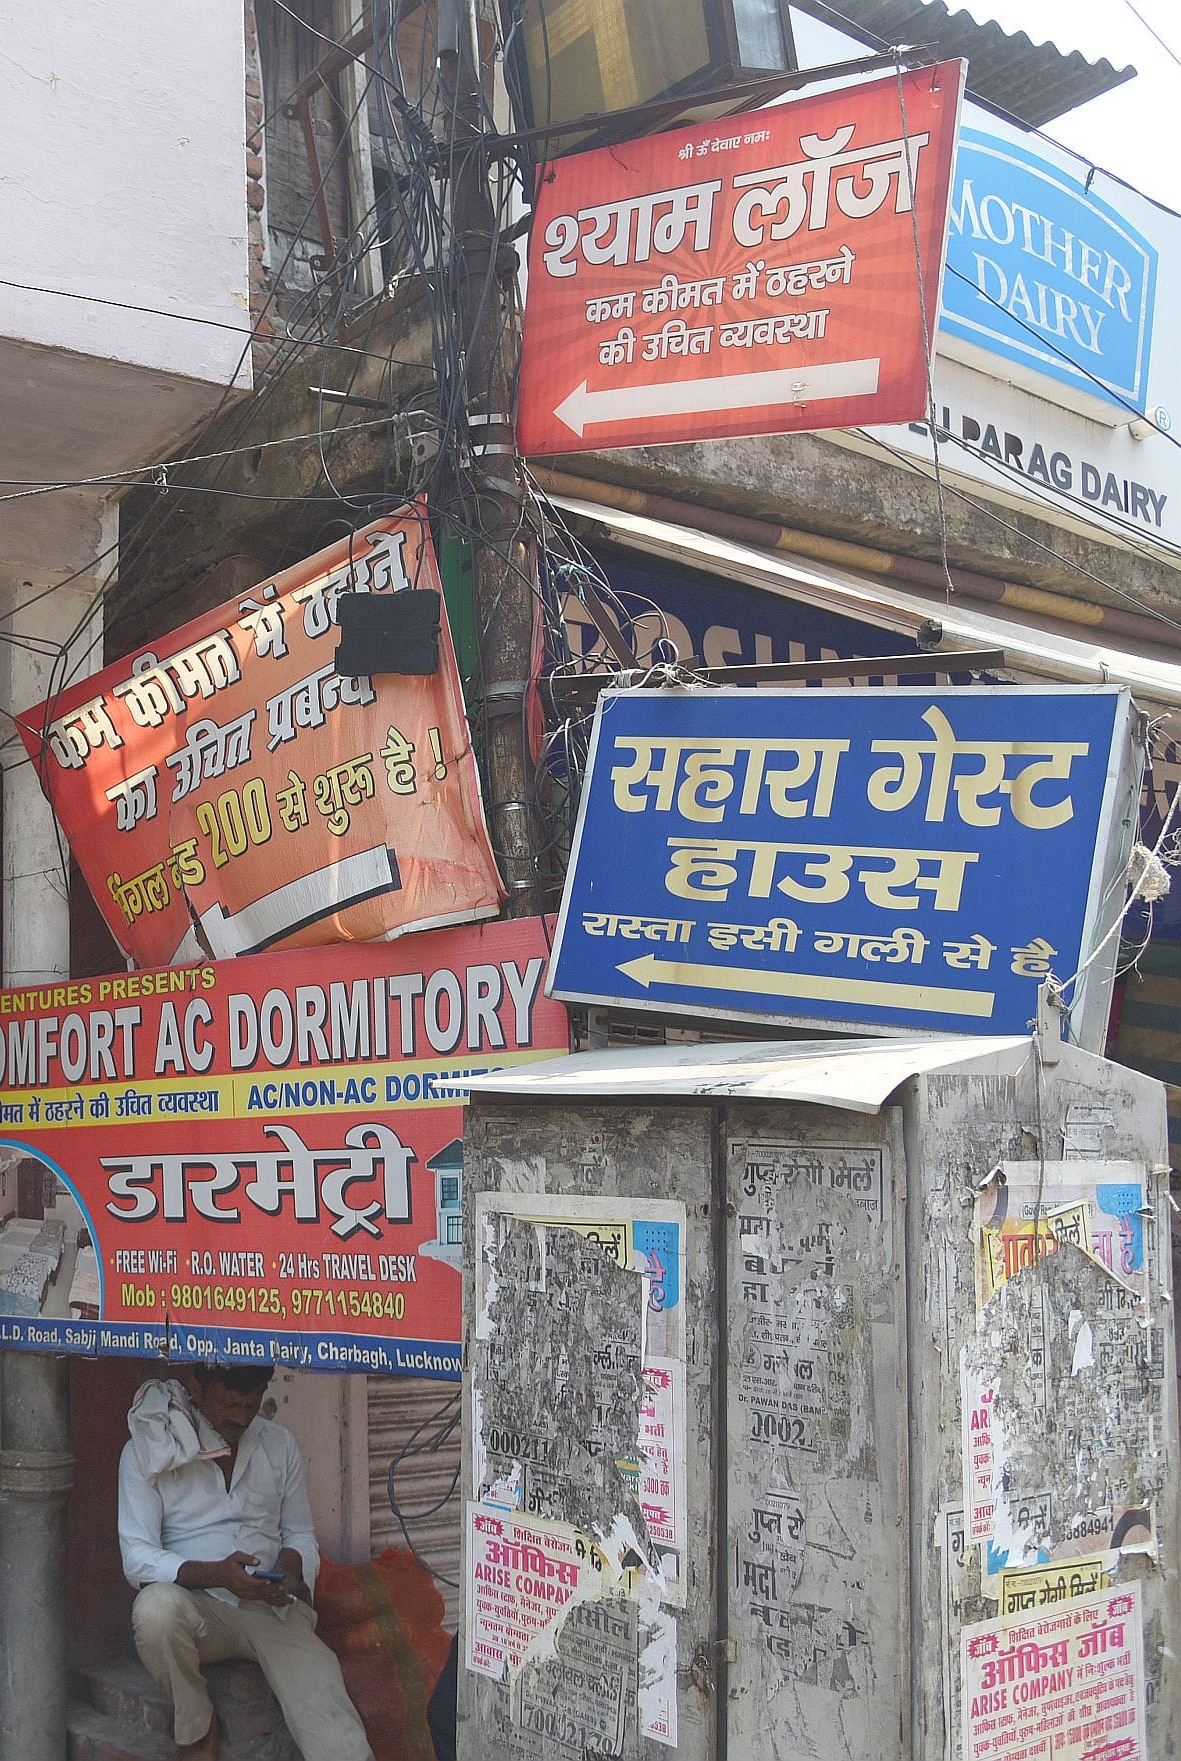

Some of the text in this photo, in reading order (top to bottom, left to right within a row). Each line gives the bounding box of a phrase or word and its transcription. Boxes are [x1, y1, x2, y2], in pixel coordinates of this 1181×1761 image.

[543, 124, 930, 278] श्याम लॉज
[585, 245, 855, 325] कम कीमत में ठहरने
[947, 178, 1133, 323] MOTHER
[598, 309, 830, 367] की उचित व्यवस्था
[972, 251, 1106, 356] DAIRY
[962, 414, 1168, 528] PARAG DAIRY
[40, 689, 123, 769] कम
[113, 629, 242, 730] कीमत
[237, 584, 288, 659] में
[105, 763, 160, 832] का
[166, 710, 256, 803] उचित
[195, 776, 273, 869] 200
[276, 770, 308, 833] से
[313, 751, 375, 836] शुरू
[380, 725, 418, 796] है
[610, 735, 850, 823] सहारा
[866, 704, 1090, 831] गेस्ट
[663, 836, 980, 911] हाउस
[581, 912, 1059, 979] रास्ता इसी गली से है
[99, 967, 217, 1002] PRESENTS
[154, 997, 216, 1076] AC
[228, 957, 545, 1070] DORMITORY
[28, 1096, 44, 1122] में
[44, 1092, 85, 1122] ठहरने
[89, 1091, 111, 1119] की
[114, 1088, 152, 1117] उचित
[157, 1090, 220, 1114] व्यवस्था
[247, 1076, 377, 1110] AC/NON-AC
[99, 1123, 417, 1240] डारमेट्री
[115, 1250, 417, 1283] FREE Wi-Fi R.O. WATER 24 Hrs TRAVEL DESK
[121, 1283, 156, 1308] Mob
[171, 1283, 287, 1321] 9801649125,
[291, 1289, 406, 1321] 9771154840
[27, 1325, 62, 1346] Road,
[65, 1327, 97, 1350] Sabji
[100, 1330, 140, 1349] Mandi
[186, 1336, 218, 1357] Opp.
[223, 1338, 265, 1358] Janta
[318, 1341, 393, 1370] Charbagh,
[396, 1348, 462, 1373] Lucknow
[751, 1396, 779, 1408] PAWAN
[475, 1562, 511, 1589] ARISE
[485, 1538, 580, 1588] ऑफिस
[980, 1619, 1126, 1690] ऑफिस जॉब
[971, 1688, 1007, 1719] ARISE
[1012, 1667, 1073, 1706] COMPANY
